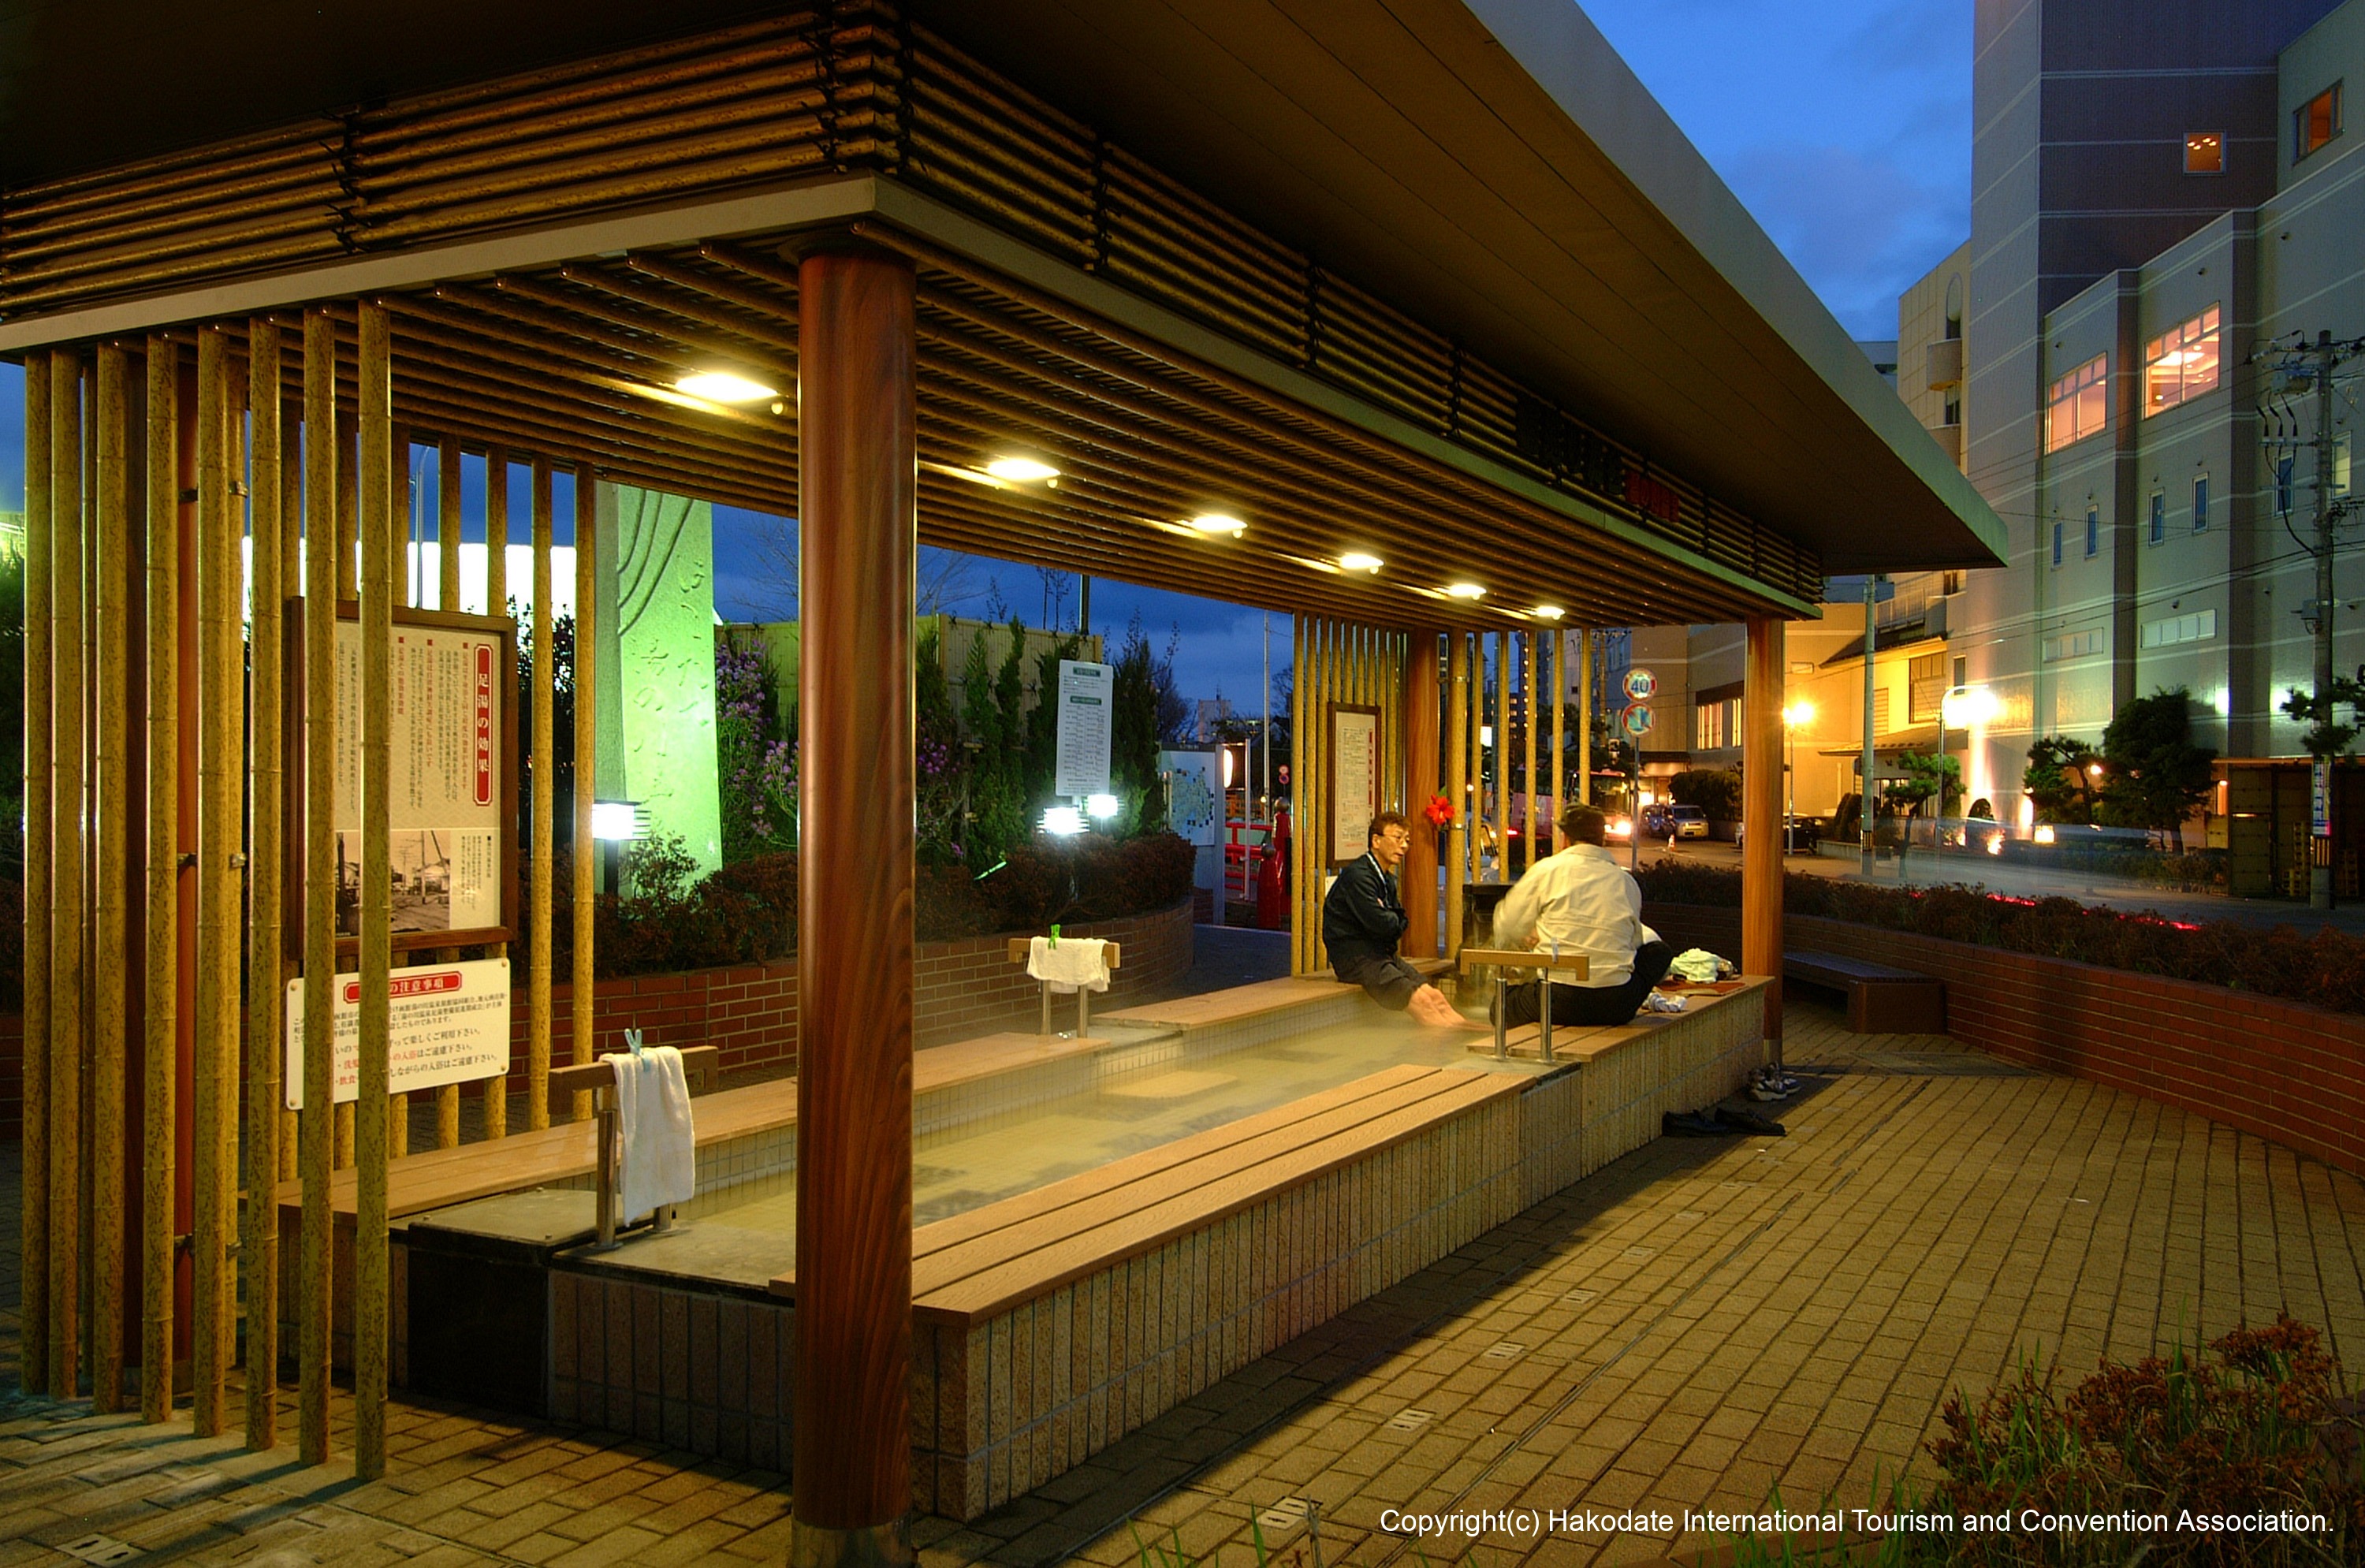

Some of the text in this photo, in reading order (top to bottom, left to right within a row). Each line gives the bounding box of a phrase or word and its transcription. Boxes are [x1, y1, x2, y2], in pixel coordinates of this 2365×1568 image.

[1630, 679, 1649, 693] 40
[478, 673, 490, 773] 足湯の効果
